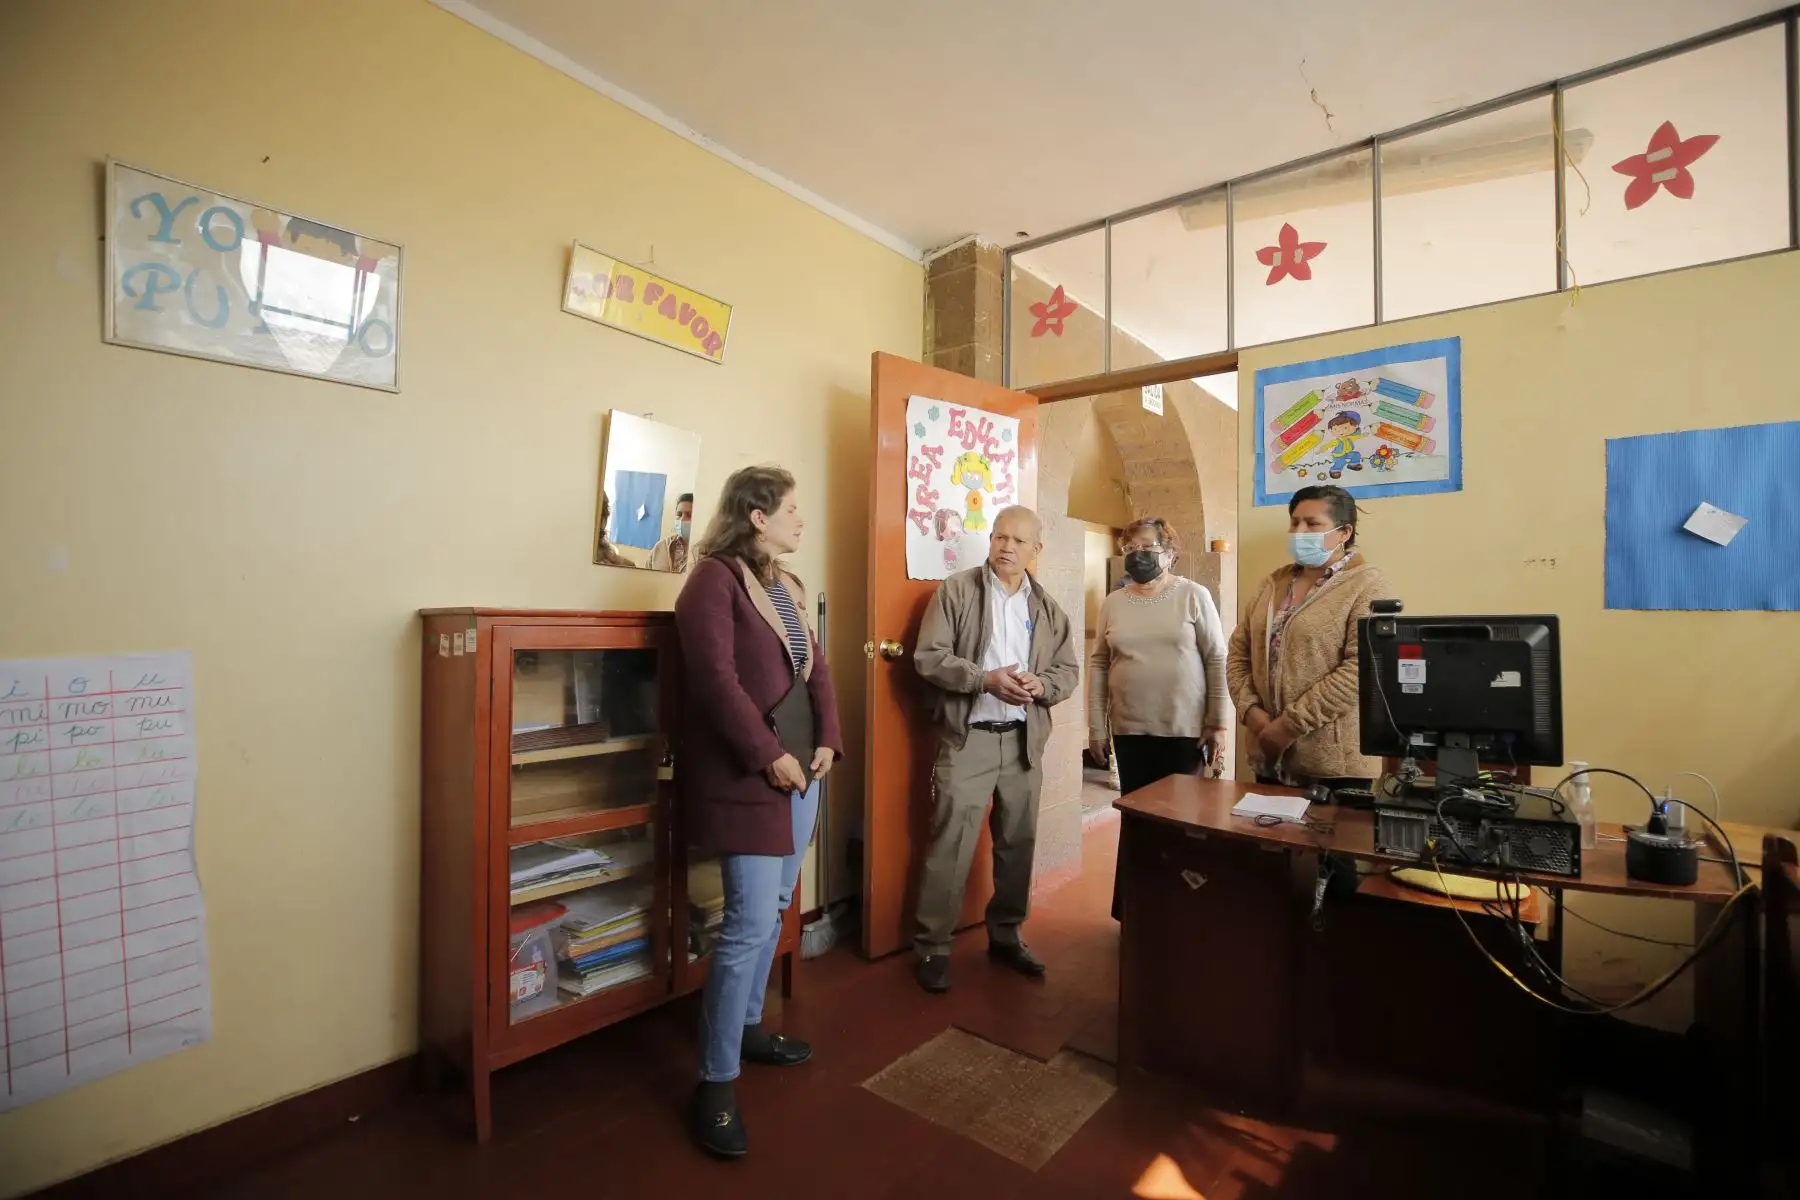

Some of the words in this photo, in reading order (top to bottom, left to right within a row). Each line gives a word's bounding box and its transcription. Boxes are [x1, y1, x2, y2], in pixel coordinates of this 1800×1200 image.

[131, 193, 245, 252] YO
[122, 262, 393, 358] PUO
[642, 282, 722, 356] FAVOR
[909, 445, 944, 536] AREA
[947, 407, 1016, 506] EDUCATI
